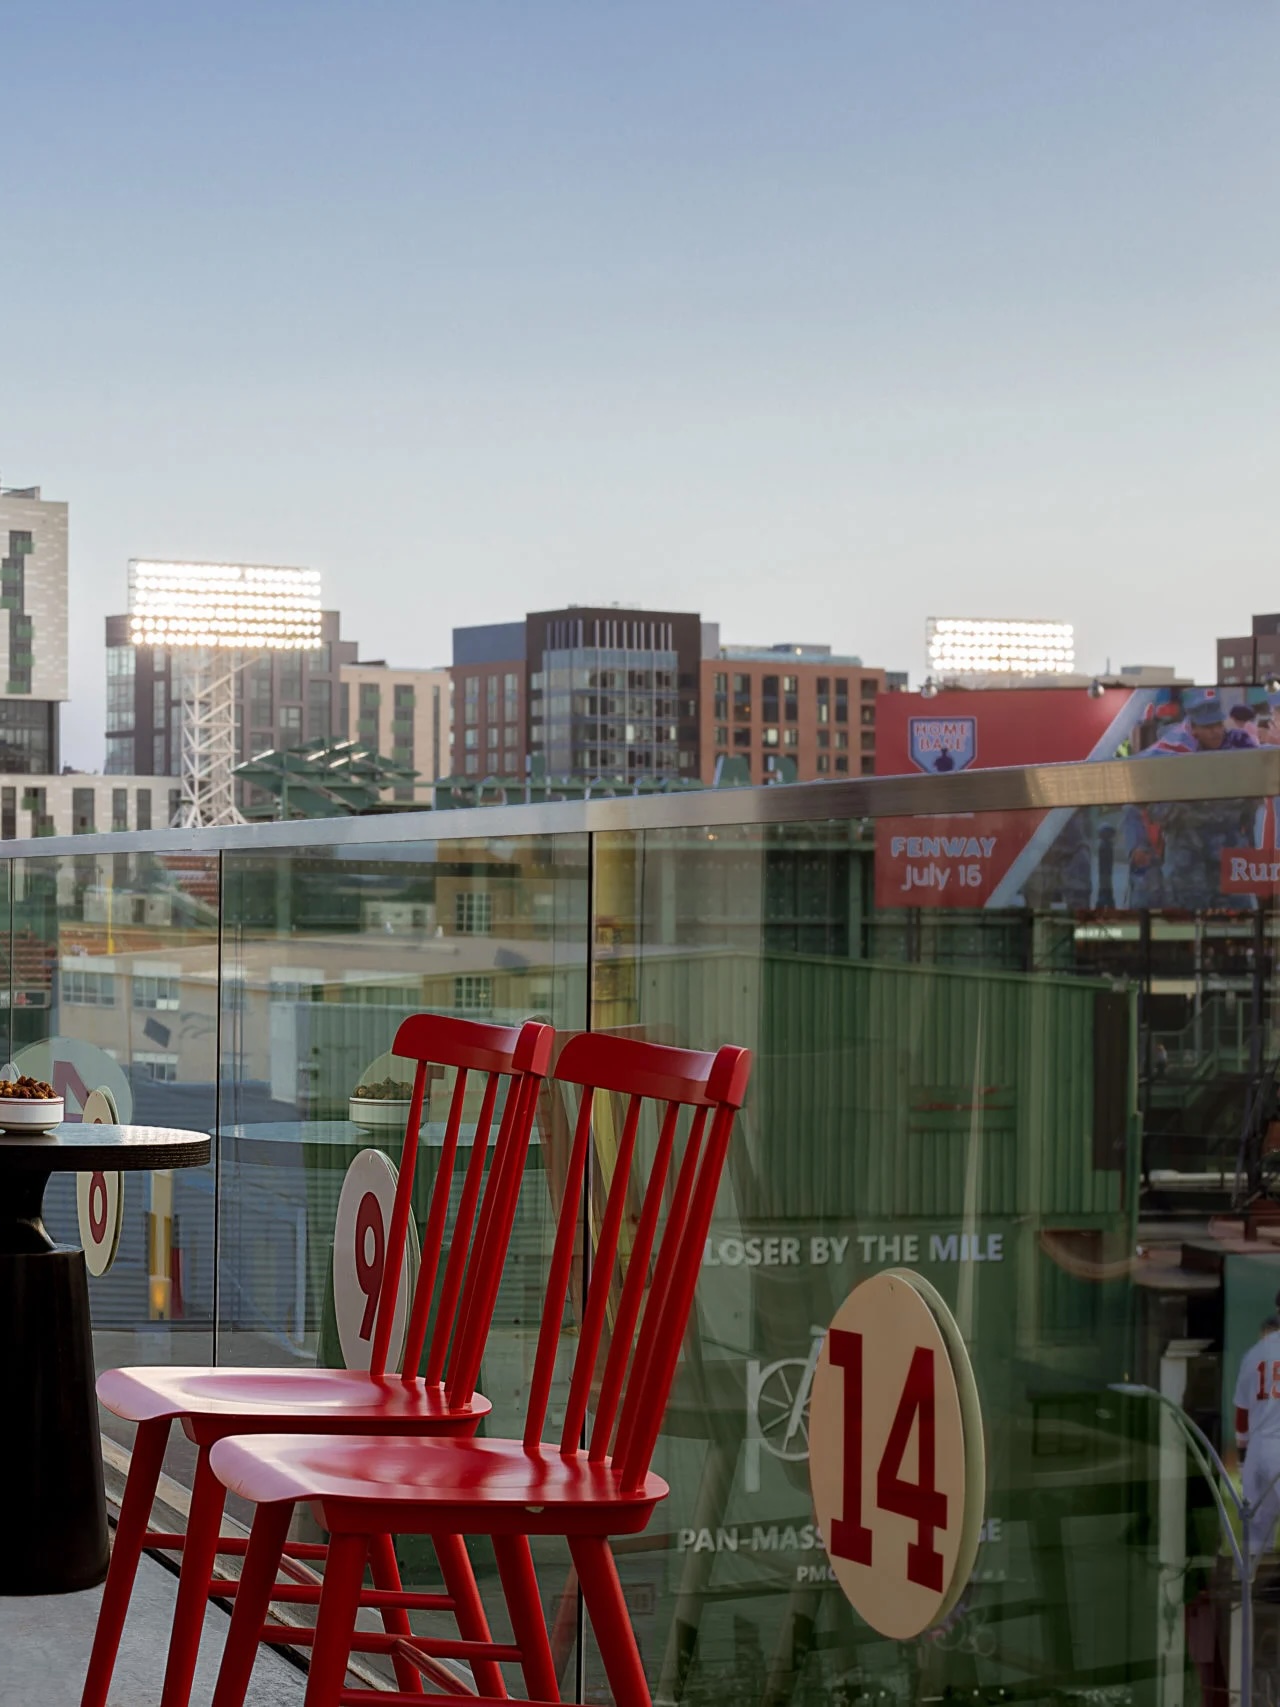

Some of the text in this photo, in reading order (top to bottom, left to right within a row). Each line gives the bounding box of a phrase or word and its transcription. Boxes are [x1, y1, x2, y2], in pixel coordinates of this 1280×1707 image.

[914, 722, 968, 737] HOME
[919, 738, 966, 753] BASE
[890, 836, 997, 858] FENWAY
[900, 862, 982, 892] July 15
[703, 1233, 1004, 1266] LOSER BY THE MILE
[355, 1191, 385, 1341] 9
[828, 1328, 949, 1593] 14
